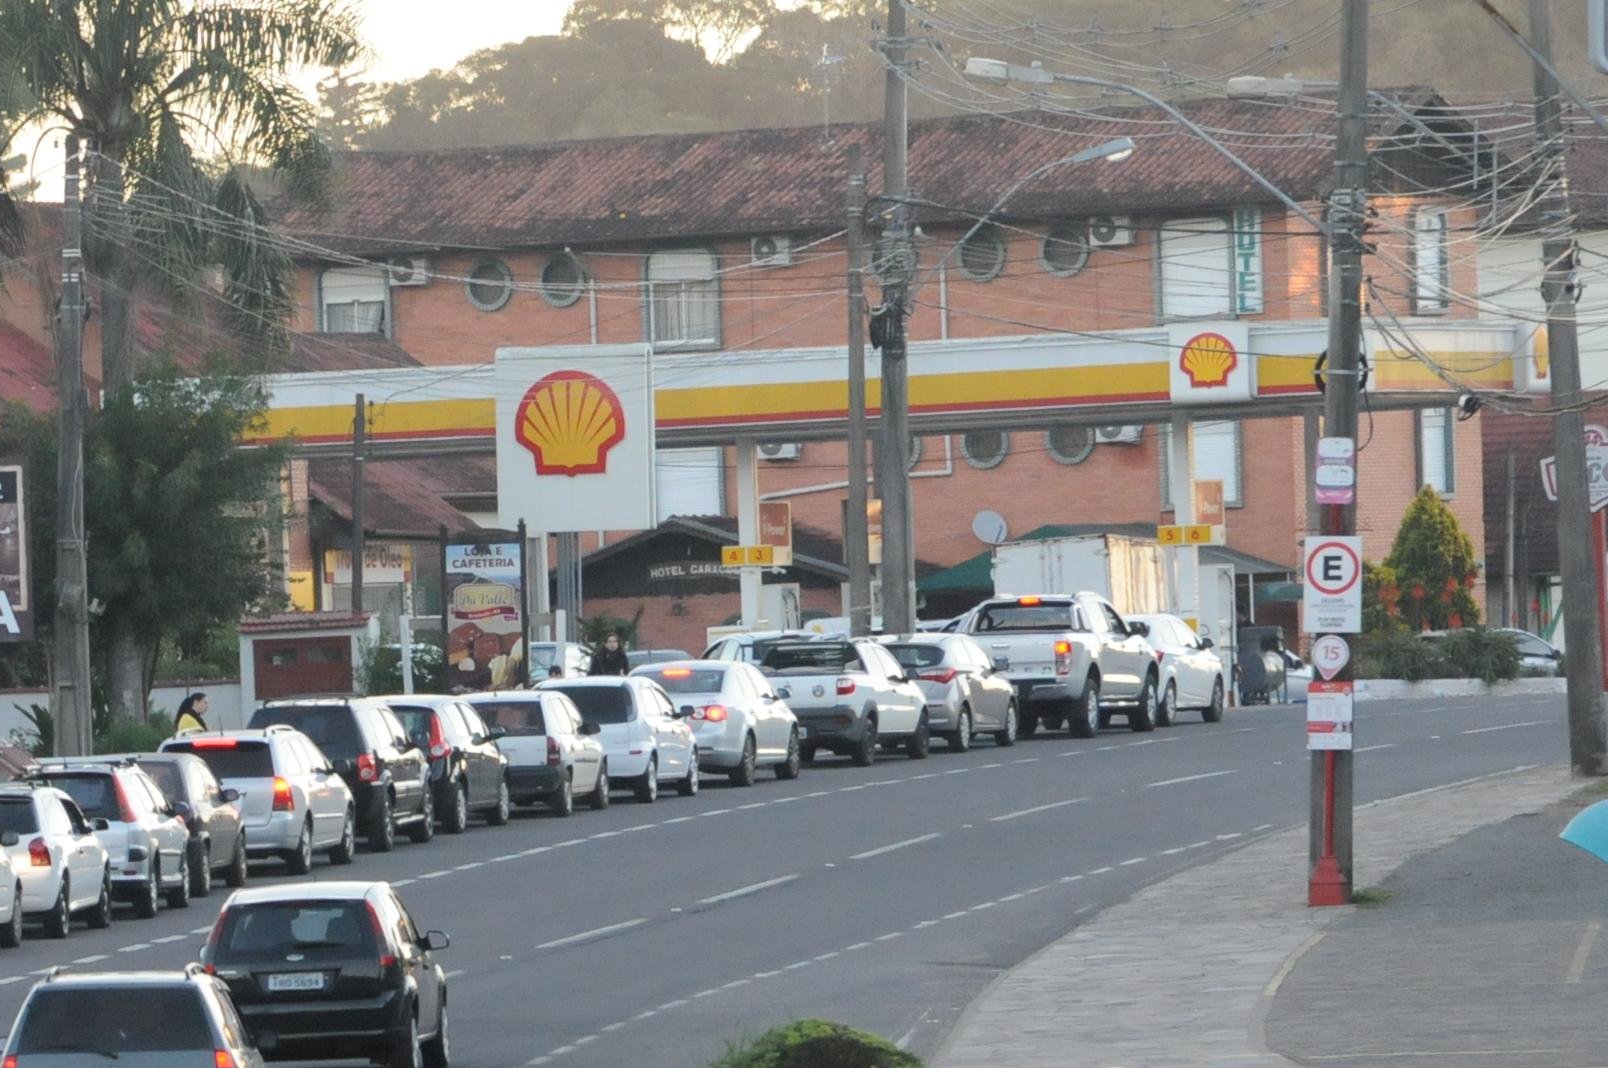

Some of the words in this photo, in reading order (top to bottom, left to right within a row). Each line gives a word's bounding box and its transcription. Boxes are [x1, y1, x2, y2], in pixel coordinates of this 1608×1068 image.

[1238, 208, 1256, 312] HOTEL
[1166, 530, 1174, 541] 5
[1191, 529, 1200, 540] 6
[496, 546, 503, 556] E
[729, 551, 737, 561] 4
[755, 550, 762, 560] 3
[452, 559, 515, 568] CAFETERIA
[1323, 556, 1342, 581] E
[650, 566, 686, 579] HOTEL
